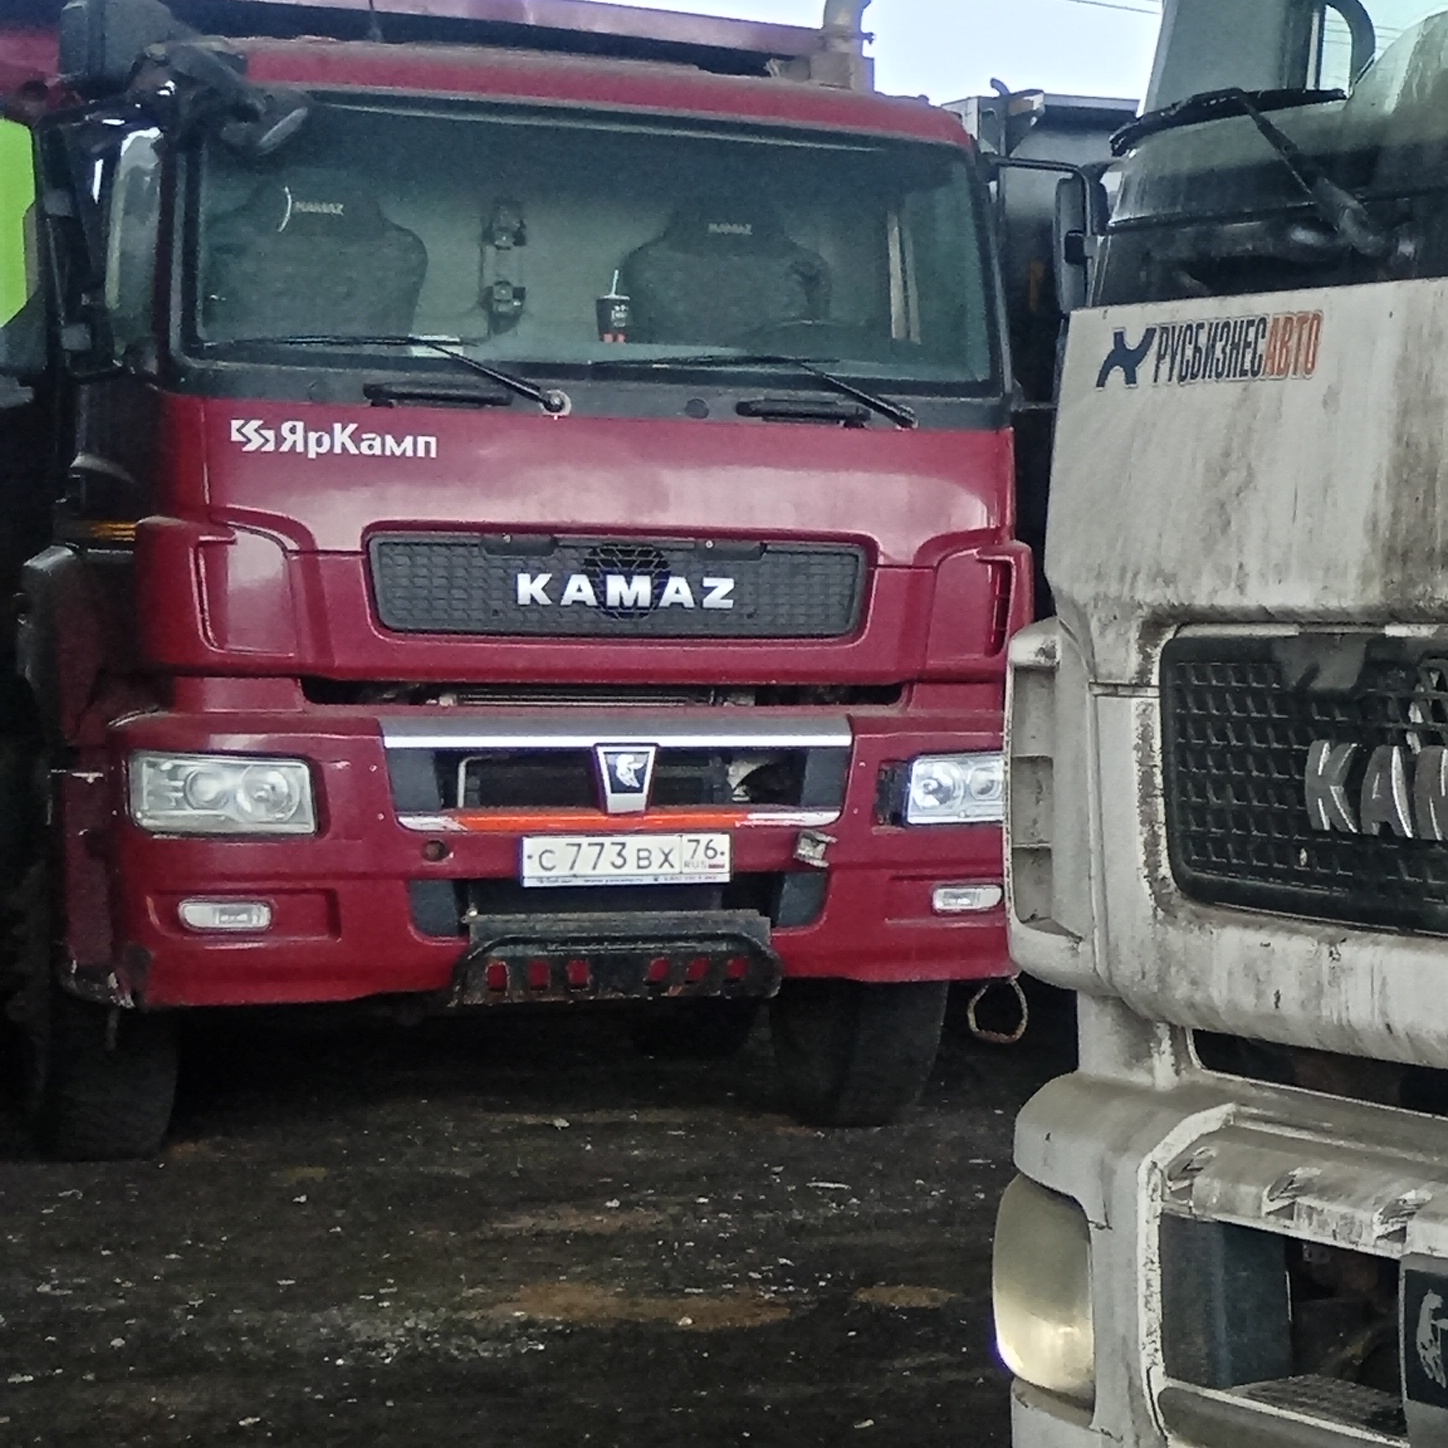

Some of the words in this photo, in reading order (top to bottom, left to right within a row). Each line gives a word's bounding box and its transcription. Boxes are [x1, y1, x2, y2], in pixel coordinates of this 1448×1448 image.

[280, 420, 437, 459] ЯрКамп
[517, 573, 735, 609] KAMAZ
[686, 838, 718, 859] 76
